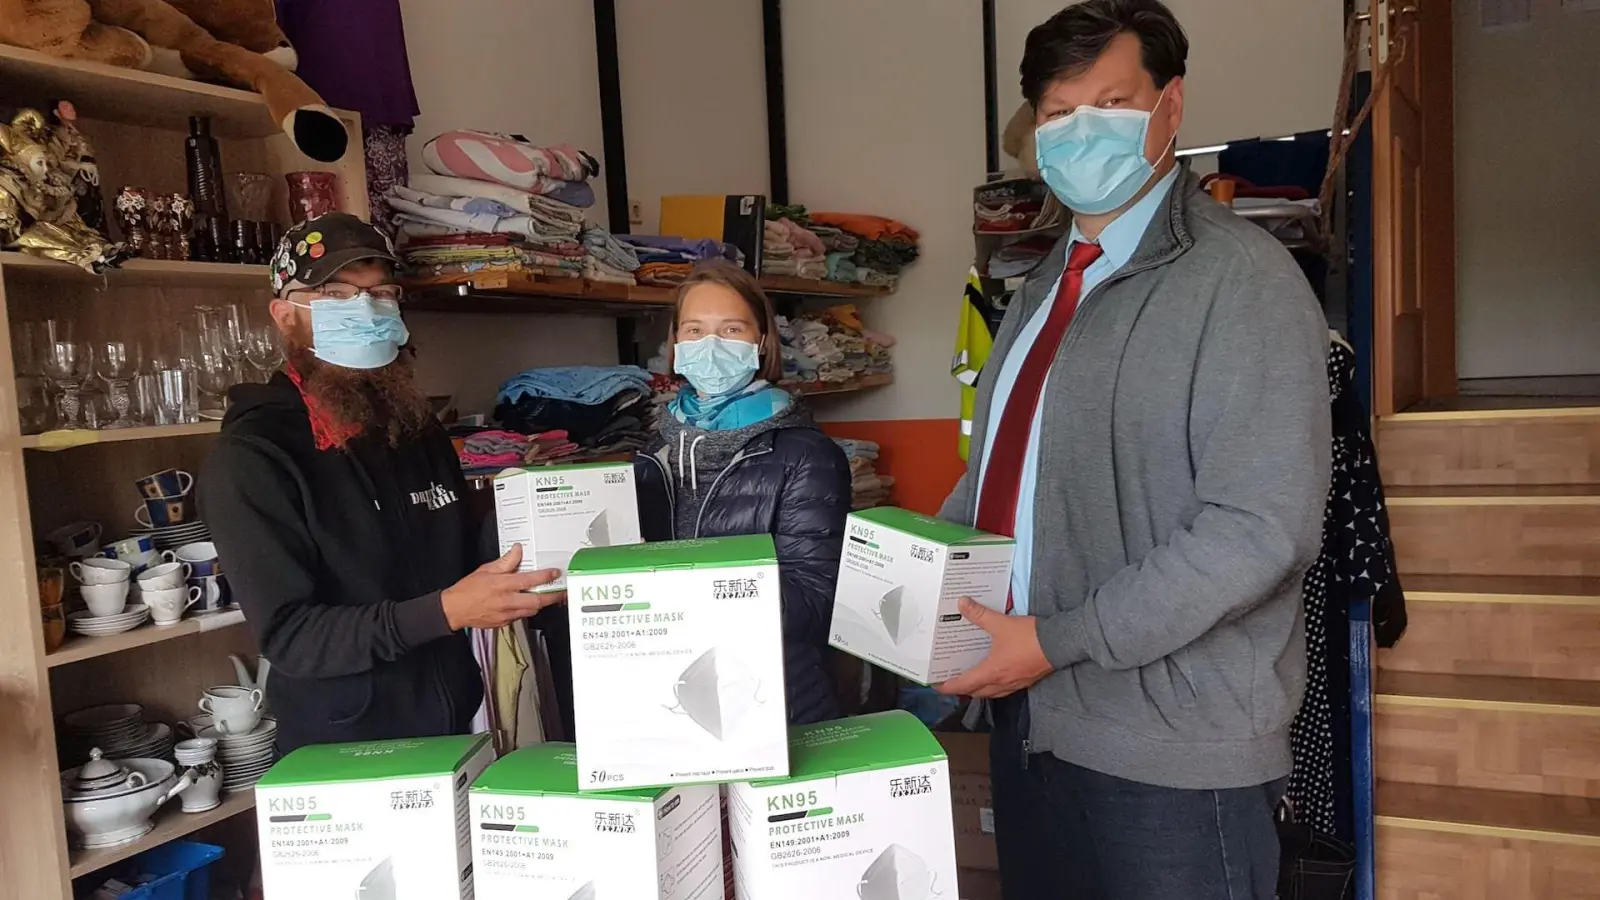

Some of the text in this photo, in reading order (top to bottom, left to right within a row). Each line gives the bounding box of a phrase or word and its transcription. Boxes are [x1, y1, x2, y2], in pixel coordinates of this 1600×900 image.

[536, 475, 565, 487] KN95
[536, 491, 574, 500] PROTECTIVE
[850, 523, 876, 540] KN95
[847, 541, 879, 558] PROTECTIVE
[879, 551, 895, 563] MASK
[581, 584, 634, 602] KN95
[713, 577, 758, 593] 乐新达
[582, 611, 684, 627] PROTECTIVE MASK
[889, 774, 931, 791] 乐新达
[269, 796, 317, 812] KN95
[390, 789, 433, 803] 乐新达
[767, 790, 818, 811] KN95
[480, 804, 525, 821] KN95
[594, 812, 635, 826] 乐新达
[270, 822, 364, 836] PROTECTIVE MASK
[769, 812, 865, 836] PROTECTIVE MASK
[481, 833, 568, 848] PROTECTIVE MASK
[770, 830, 851, 849] EN149:2001+A1:2009
[770, 846, 822, 860] GB2626-2006
[784, 858, 809, 867] PRODUCT
[855, 848, 874, 856] DEVICE
